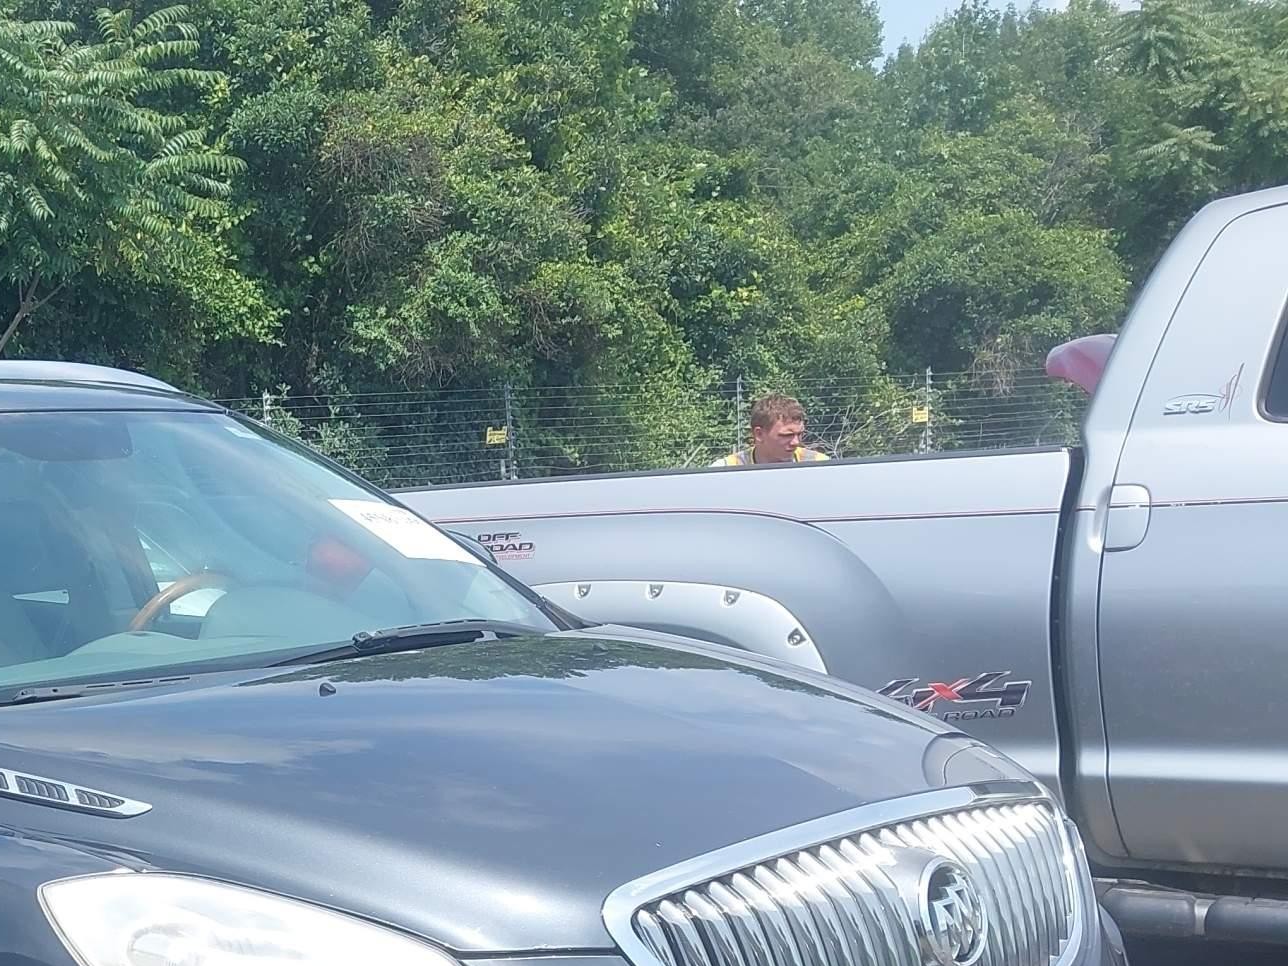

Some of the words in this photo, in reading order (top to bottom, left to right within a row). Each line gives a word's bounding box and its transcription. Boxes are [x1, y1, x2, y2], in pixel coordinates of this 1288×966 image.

[1163, 399, 1216, 416] SR5
[477, 532, 521, 543] OFF
[486, 542, 534, 553] OAD
